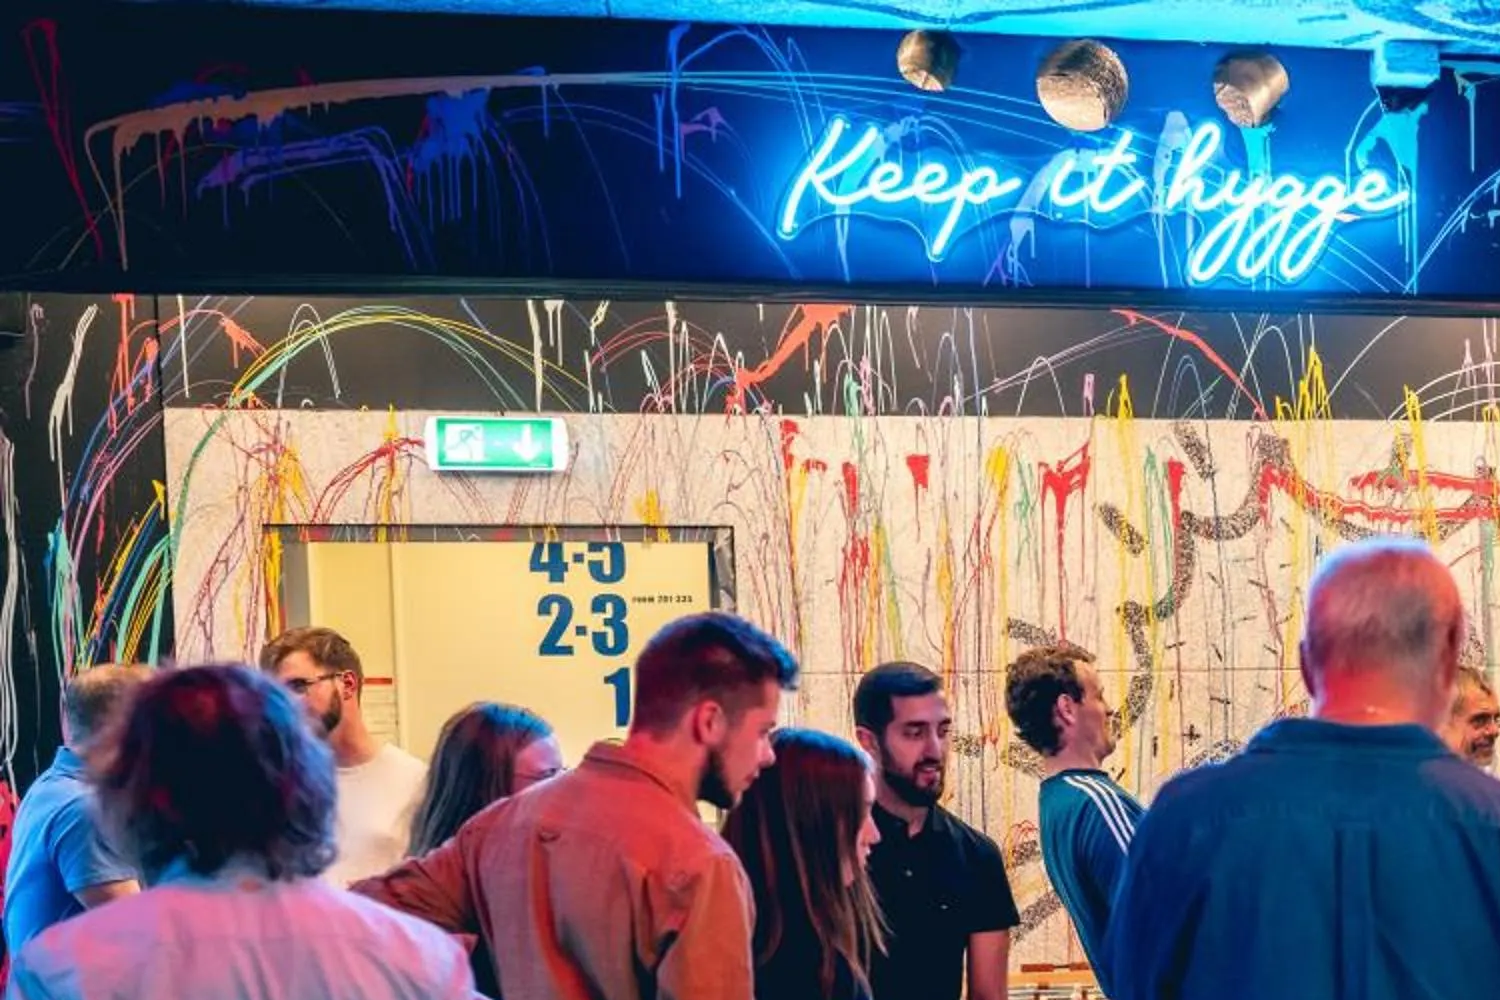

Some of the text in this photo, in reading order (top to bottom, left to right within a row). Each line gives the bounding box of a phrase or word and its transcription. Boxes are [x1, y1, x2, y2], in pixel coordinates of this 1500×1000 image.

[779, 116, 1411, 284] Keep it hygge
[529, 542, 627, 583] 4-5
[537, 594, 629, 656] 2-3
[604, 667, 631, 727] 1
